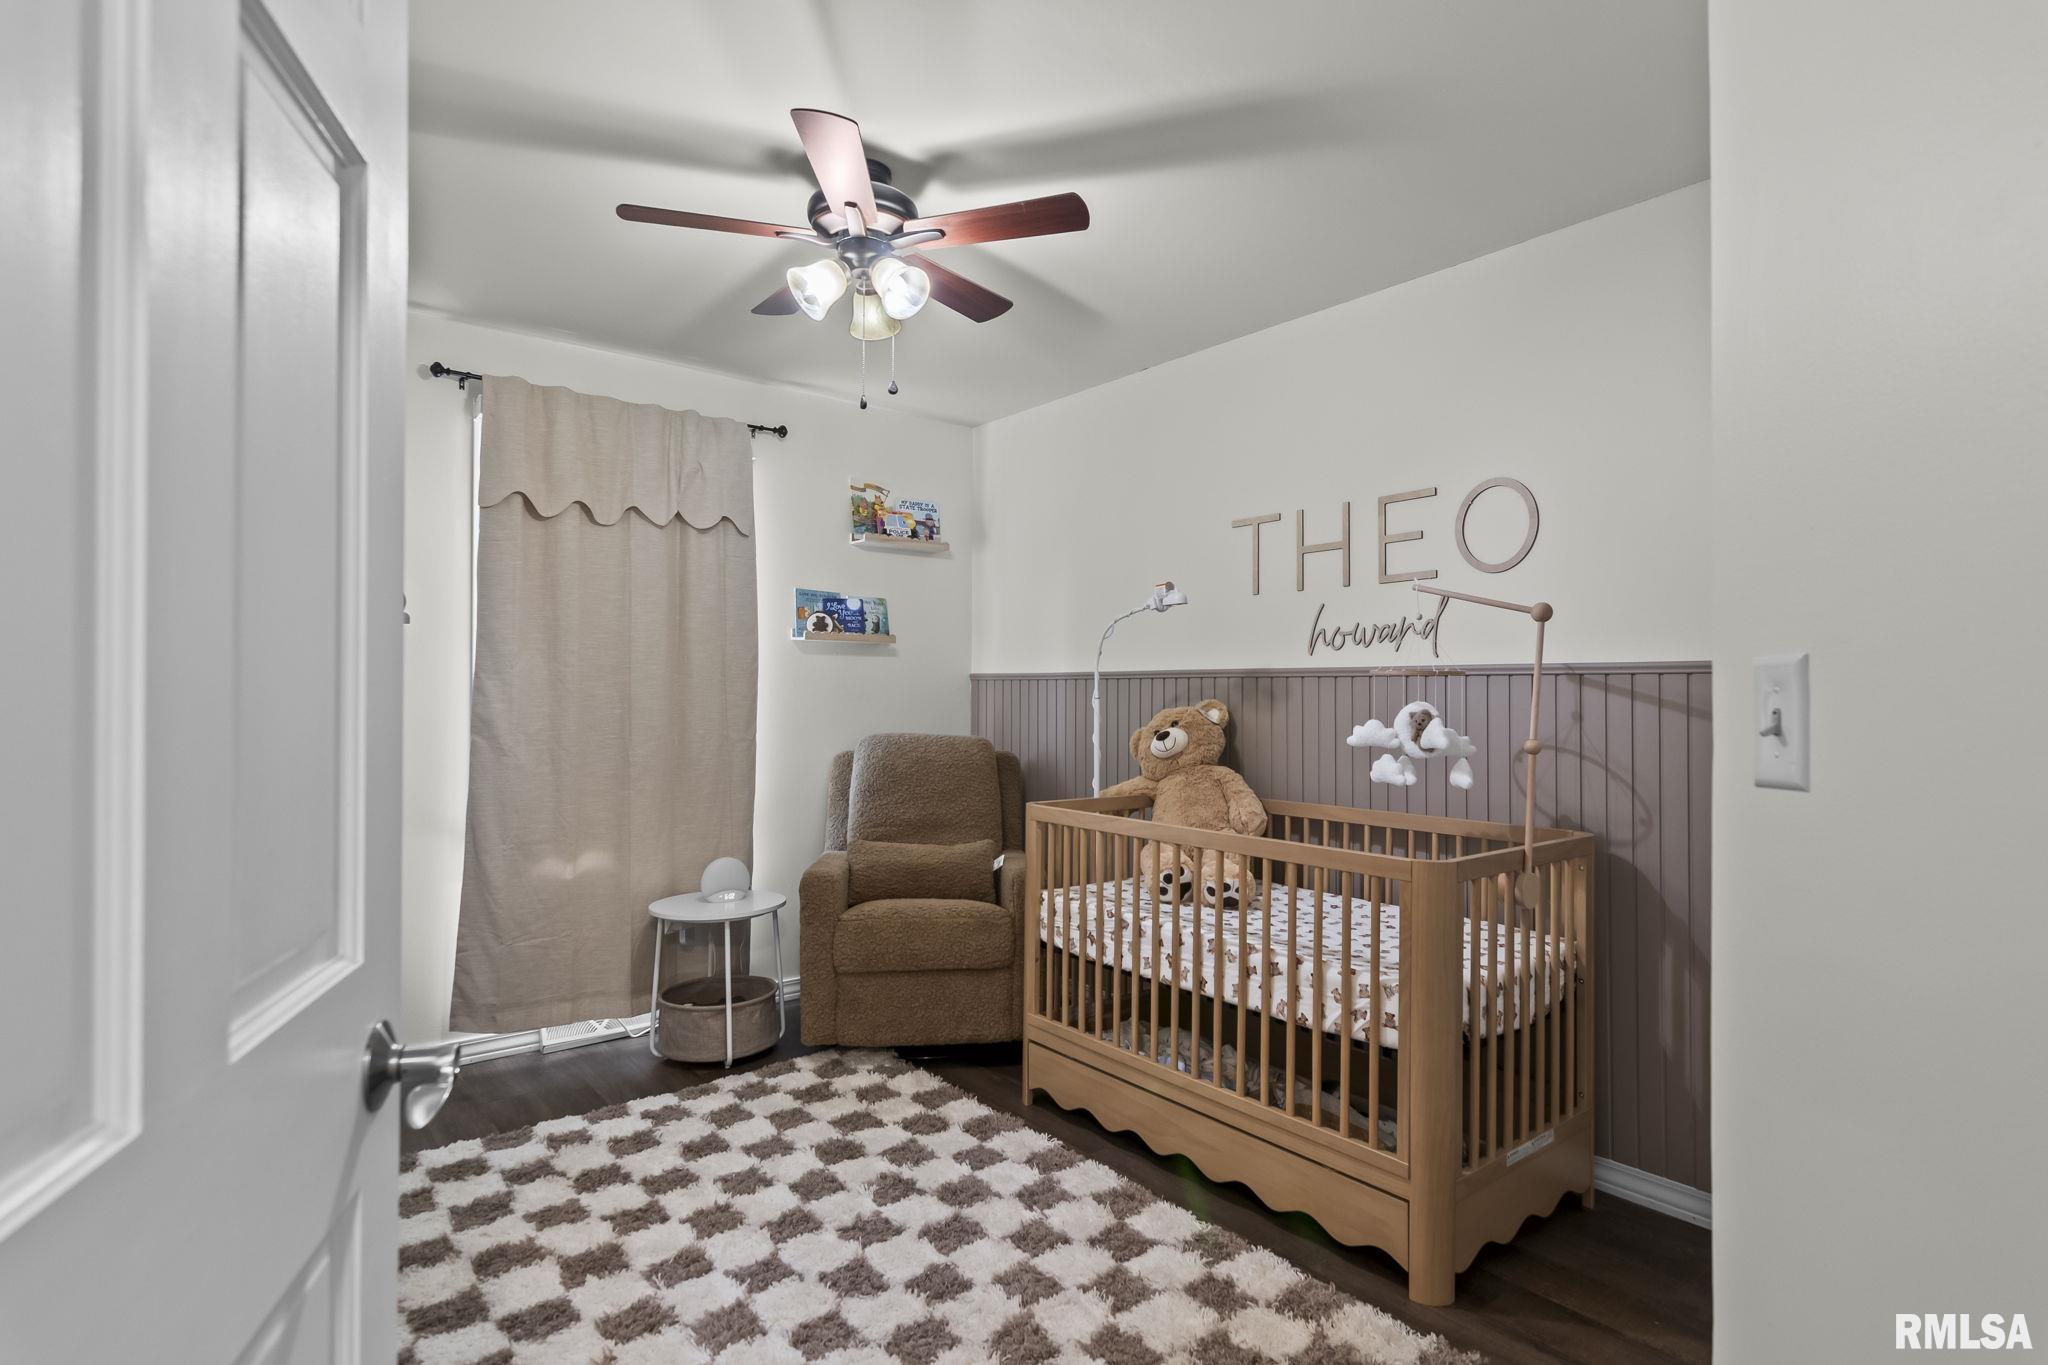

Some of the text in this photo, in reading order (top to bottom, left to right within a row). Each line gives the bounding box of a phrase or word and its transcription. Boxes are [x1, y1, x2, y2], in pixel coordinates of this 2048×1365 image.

[1232, 477, 1539, 595] THEO
[830, 602, 846, 612] Love
[838, 609, 853, 619] You
[1308, 596, 1449, 658] howard
